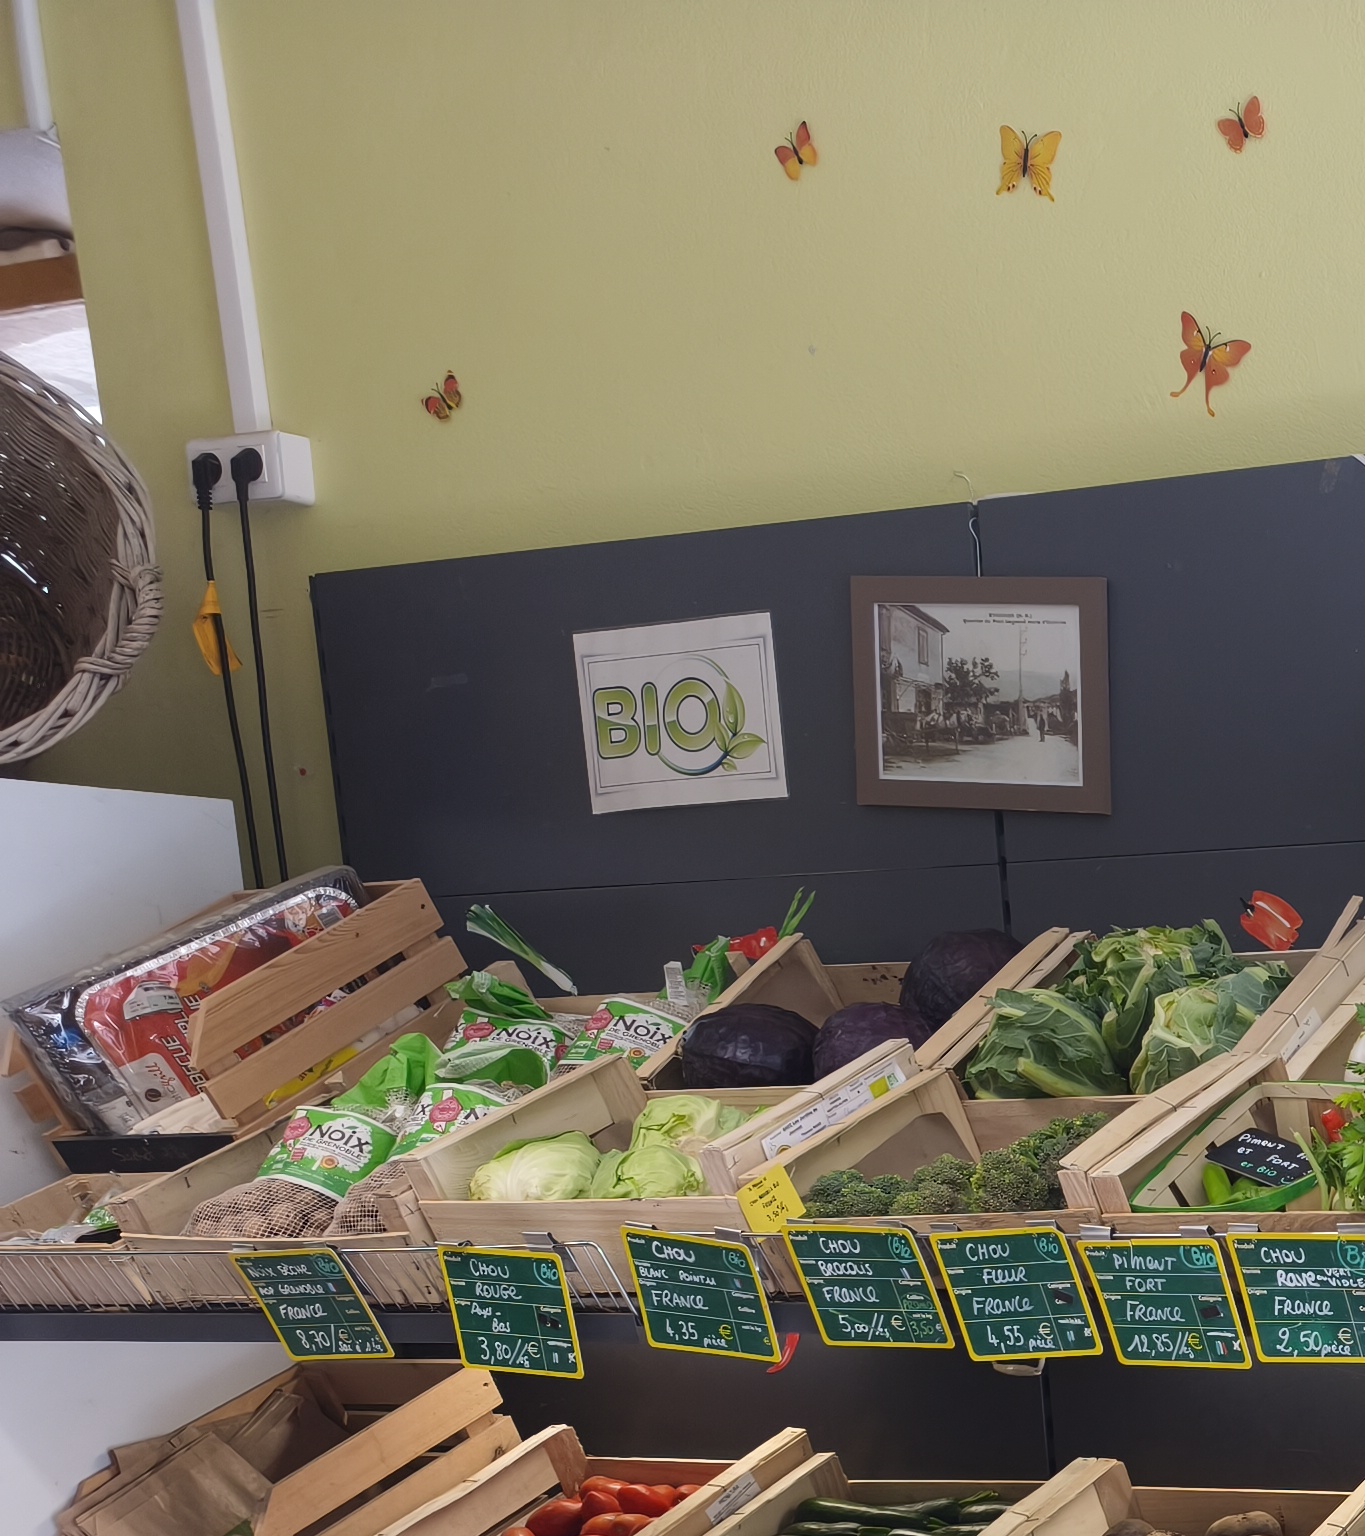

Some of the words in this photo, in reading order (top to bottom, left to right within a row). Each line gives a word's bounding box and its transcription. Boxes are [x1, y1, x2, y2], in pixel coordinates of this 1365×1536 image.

[593, 677, 722, 760] BIO
[309, 1124, 371, 1154] NOIX
[316, 1139, 364, 1161] GRENOBLE
[651, 1241, 696, 1263] CHOU
[818, 1238, 861, 1254] CHOU
[965, 1243, 1010, 1262] CHOU
[1259, 1247, 1306, 1265] CHOU
[469, 1259, 510, 1279] CHOU
[1125, 1276, 1167, 1292] FORT
